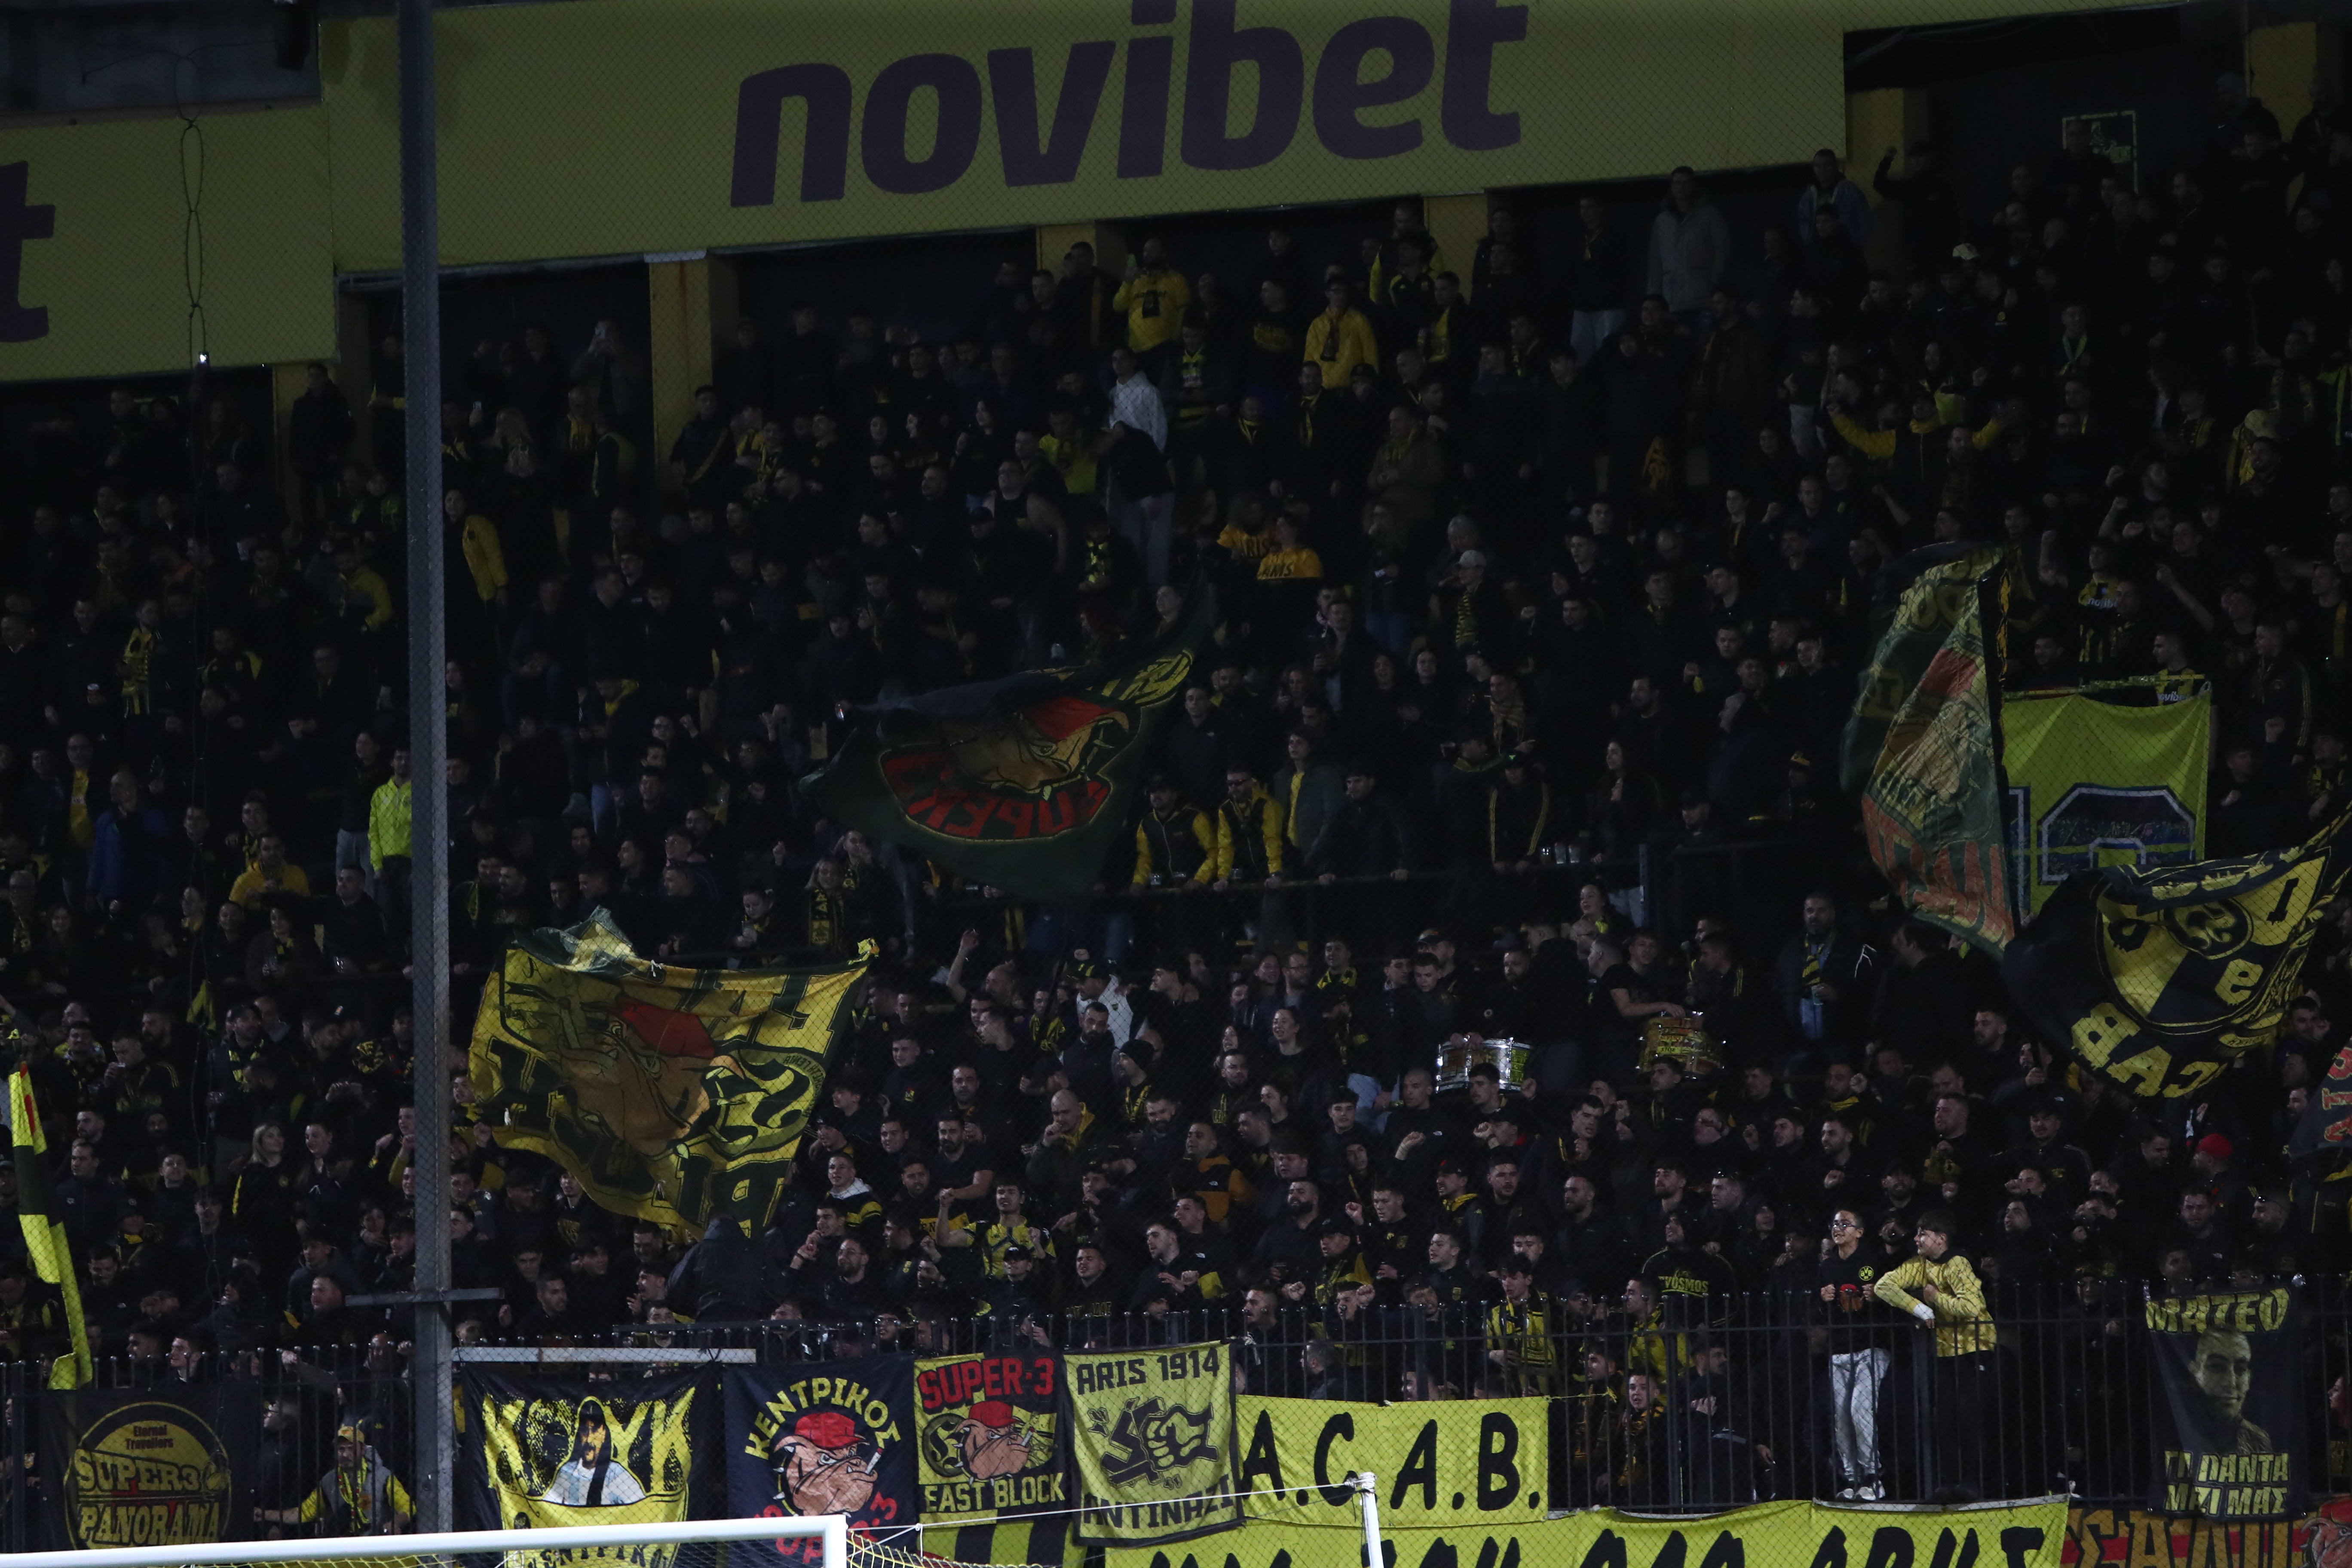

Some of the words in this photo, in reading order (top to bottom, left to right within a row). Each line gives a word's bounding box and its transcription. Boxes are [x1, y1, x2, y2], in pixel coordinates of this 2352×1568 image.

[730, 0, 1528, 206] novibet
[2088, 597, 2117, 609] novib
[918, 1357, 1055, 1410] SUPER-3
[1077, 1358, 1146, 1395] ARIS
[1158, 1348, 1219, 1381] 1914
[74, 1449, 200, 1491] SUPER3
[1240, 1409, 1540, 1511] A.CA.B.
[924, 1482, 986, 1513] EAST
[993, 1472, 1066, 1507] BLOCK
[78, 1502, 220, 1546] PANORAMA
